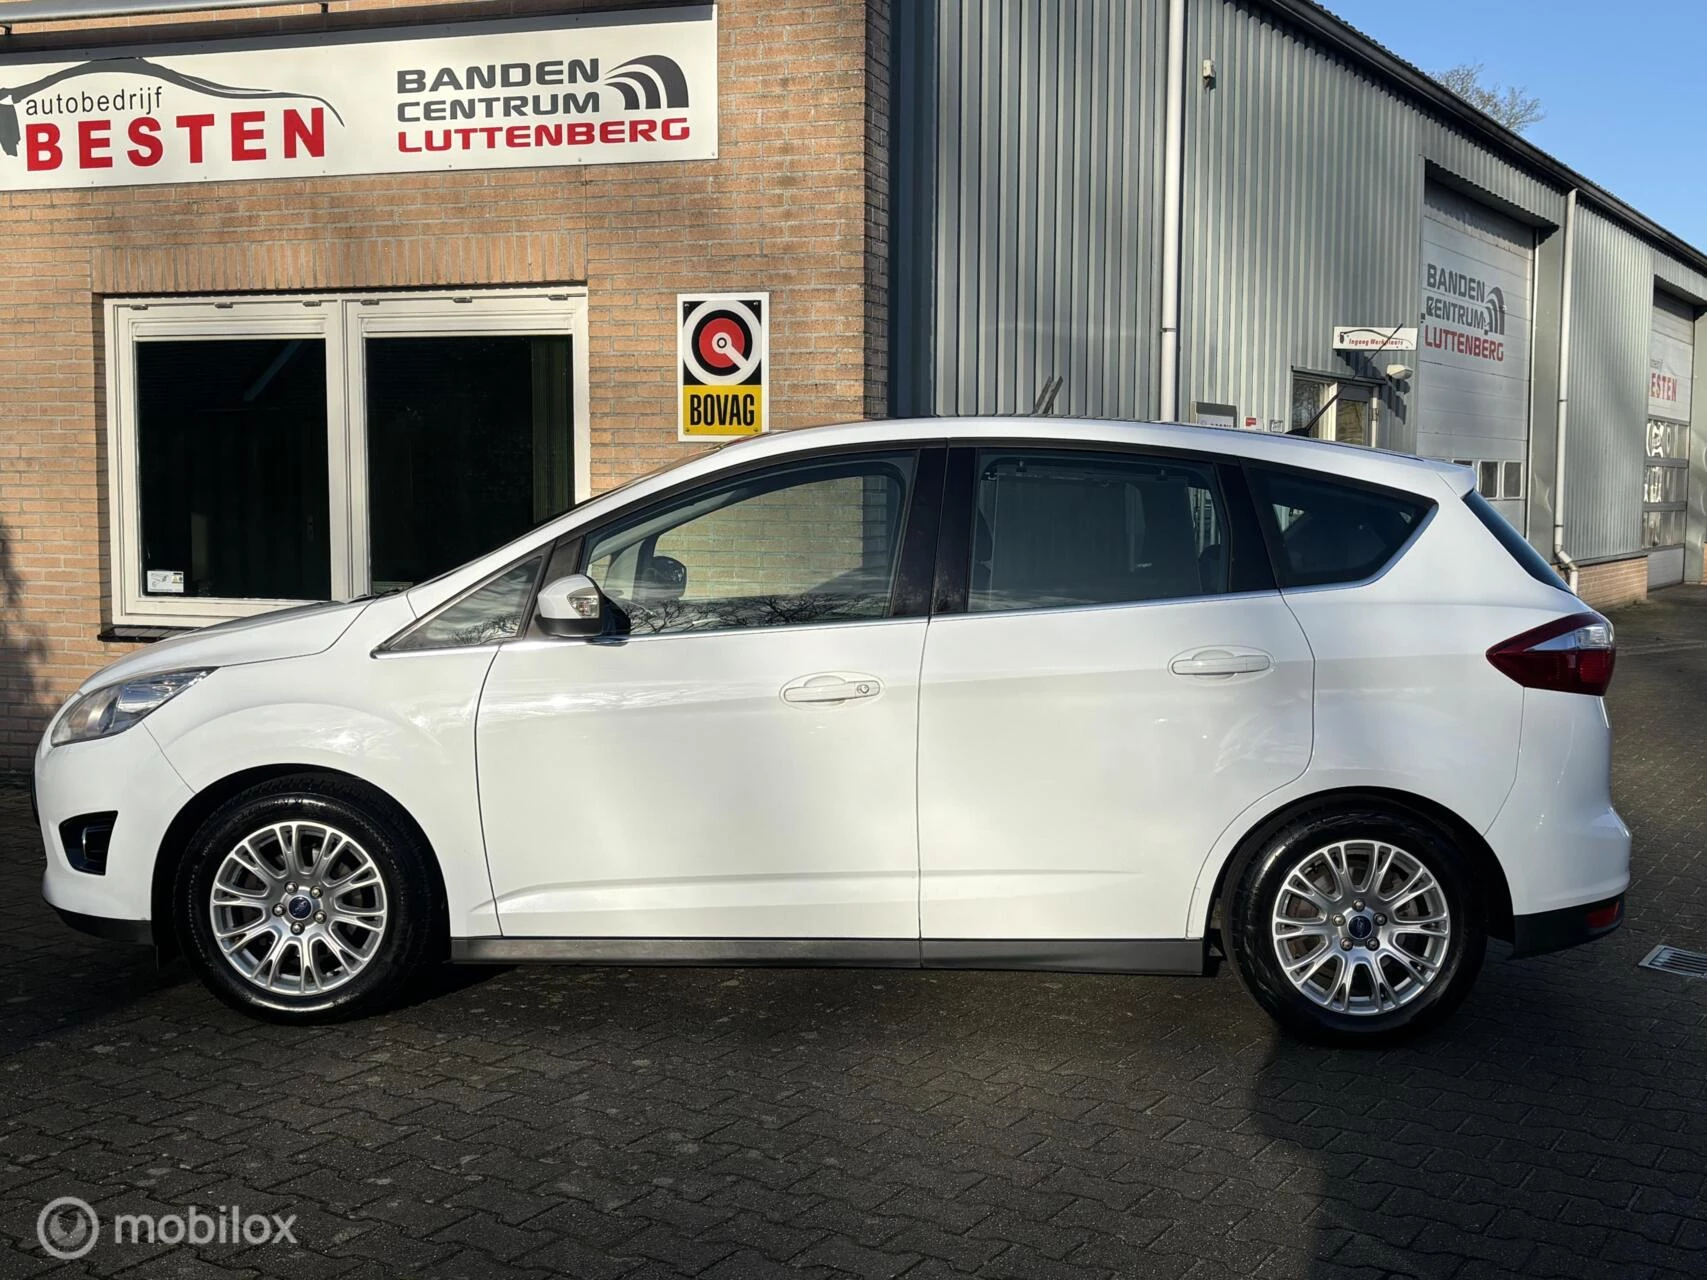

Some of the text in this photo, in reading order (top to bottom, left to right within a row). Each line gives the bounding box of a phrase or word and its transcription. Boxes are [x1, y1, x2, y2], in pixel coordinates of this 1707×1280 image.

[397, 58, 599, 94] BANDEN
[26, 86, 163, 116] autobedrijf
[397, 91, 600, 122] CENTRUM
[26, 107, 325, 171] BESTEN
[398, 117, 690, 153] LUTTENBERG
[1427, 263, 1485, 303] BANDEN
[1426, 296, 1486, 330] CENTRUM
[1425, 324, 1504, 362] LUTTENBERG
[1650, 372, 1677, 402] ESTEN
[690, 393, 755, 426] BOVAG
